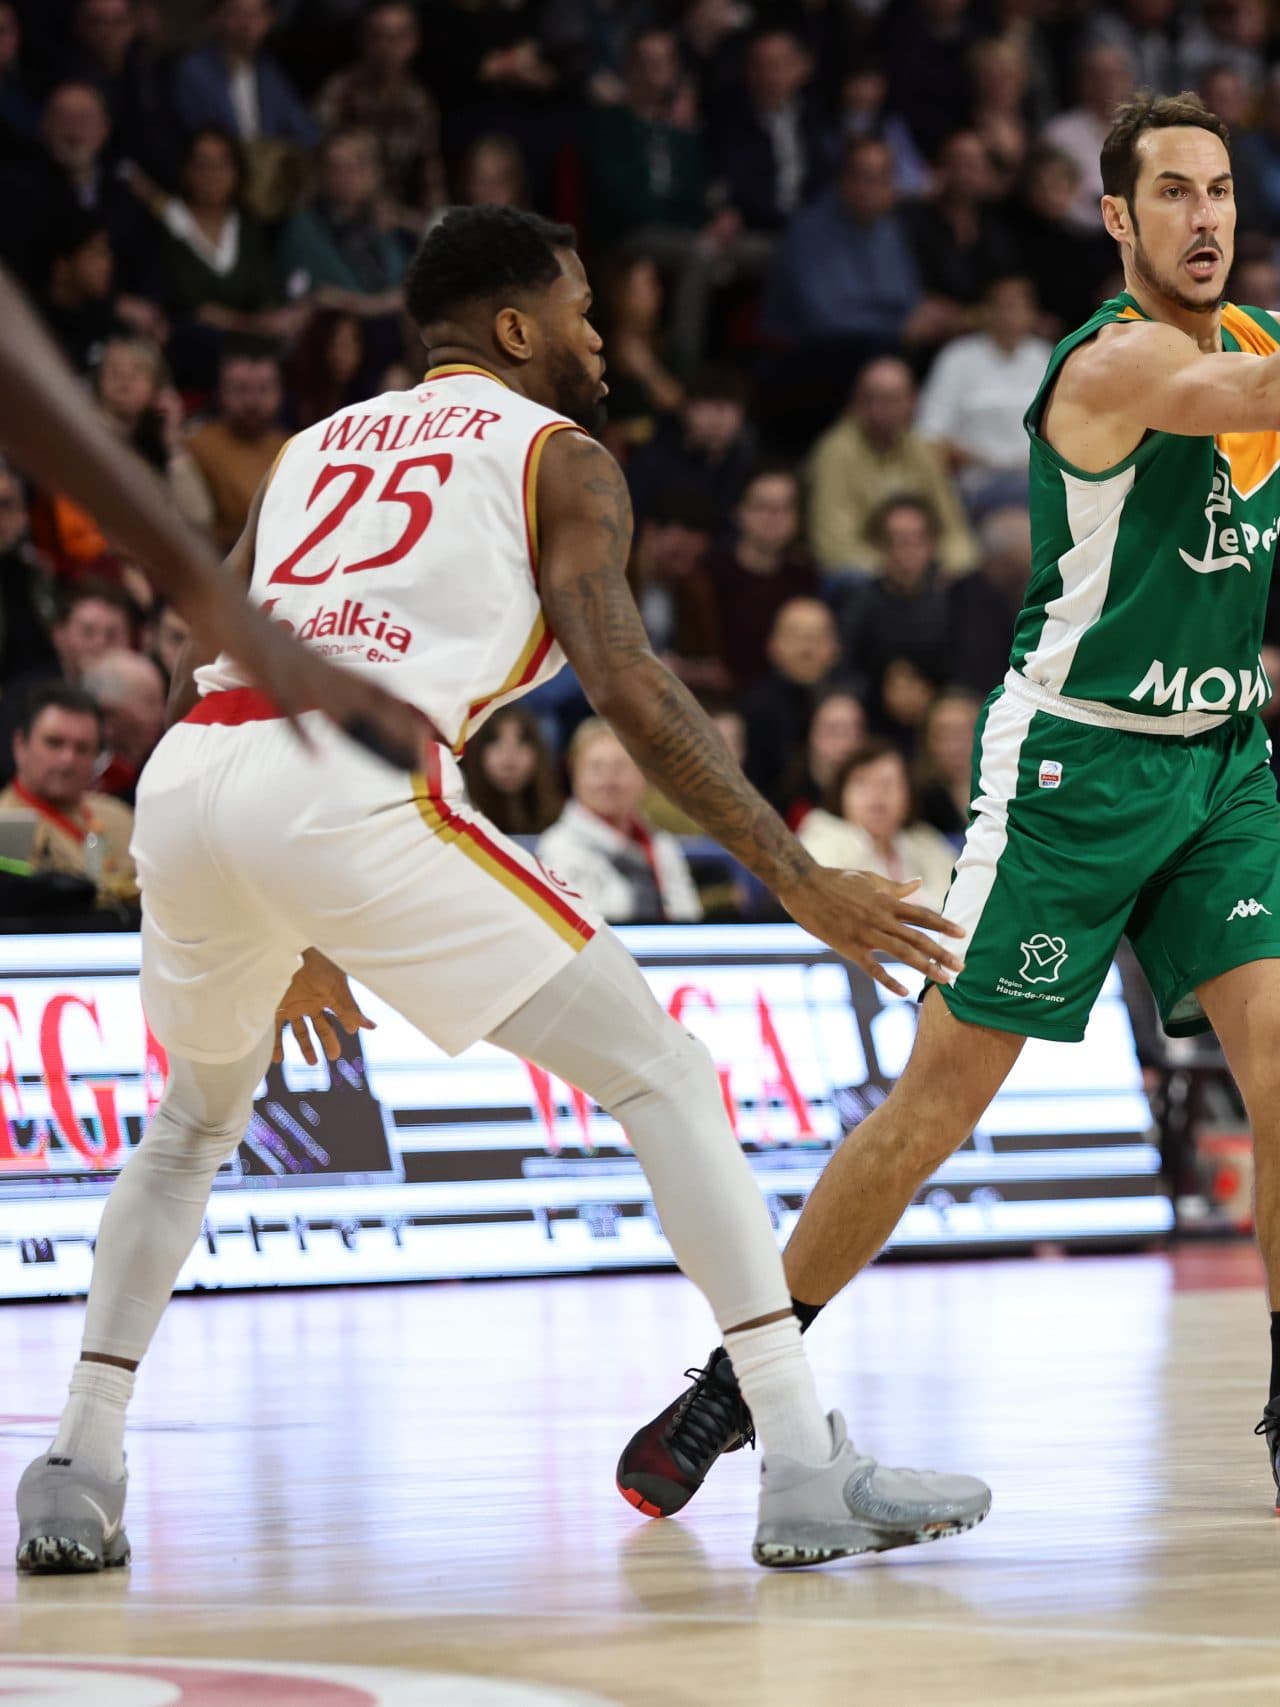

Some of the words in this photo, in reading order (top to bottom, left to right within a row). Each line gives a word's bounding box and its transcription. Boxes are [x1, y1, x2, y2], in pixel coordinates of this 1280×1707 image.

[318, 406, 502, 452] WALKER
[267, 453, 453, 586] 25
[297, 599, 412, 653] dalkia
[996, 984, 1065, 1003] Hauts-de-France
[999, 977, 1023, 988] Région
